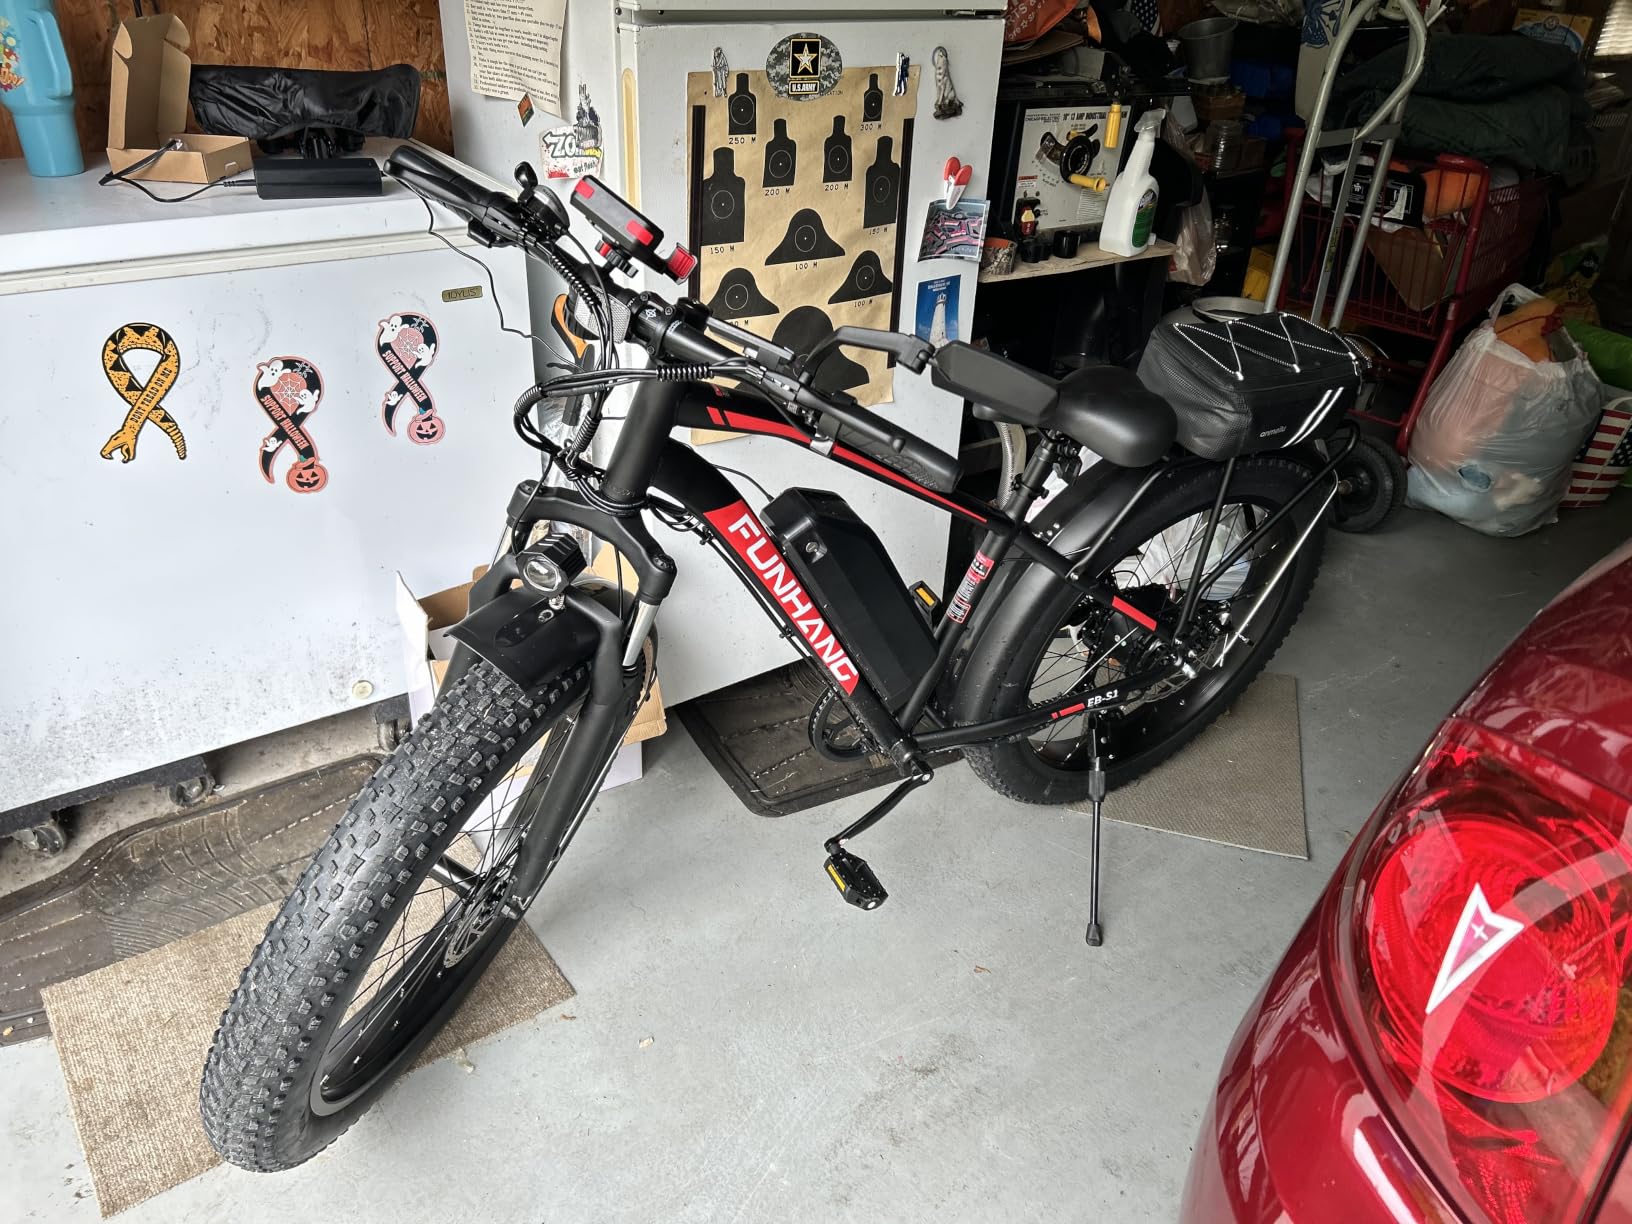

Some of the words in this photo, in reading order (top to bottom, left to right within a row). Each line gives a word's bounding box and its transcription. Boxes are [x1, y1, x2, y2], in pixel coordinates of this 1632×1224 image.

[860, 123, 874, 131] 300
[728, 136, 745, 145] 250
[751, 136, 756, 144] M
[824, 184, 839, 192] 200
[765, 189, 780, 197] 200
[869, 227, 881, 236] 150
[710, 246, 725, 255] 150
[795, 262, 811, 271] 100
[854, 300, 867, 308] 100
[381, 350, 404, 375] SUPPORT
[401, 371, 427, 403] HALLOWEEN
[144, 387, 157, 408] TREAD
[156, 378, 166, 389] ON
[161, 368, 173, 381] ME
[260, 394, 284, 421] SUPPORT
[280, 416, 310, 450] HALLOWEEN
[727, 513, 858, 682] FUNHANG
[1087, 689, 1119, 708] EB-S1
